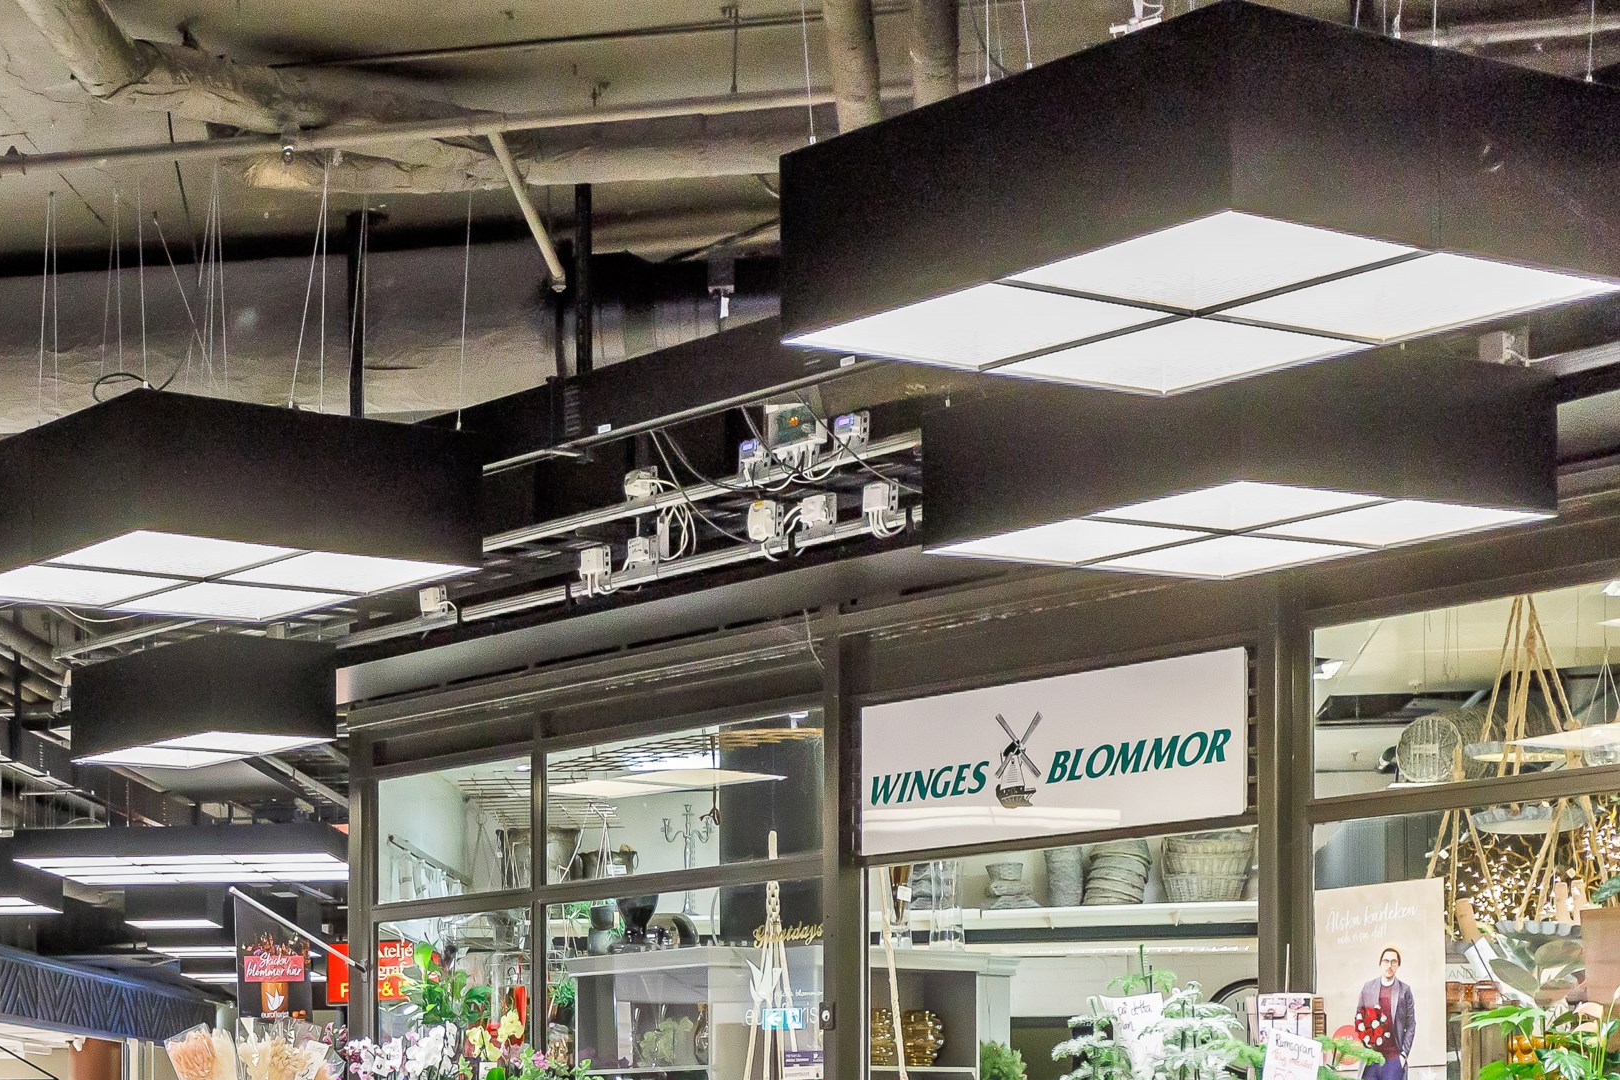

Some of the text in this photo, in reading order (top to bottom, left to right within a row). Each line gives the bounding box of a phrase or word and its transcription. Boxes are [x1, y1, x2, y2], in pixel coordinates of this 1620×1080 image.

[870, 728, 1232, 807] WINGES BLOMMOR
[259, 951, 290, 967] Skicka
